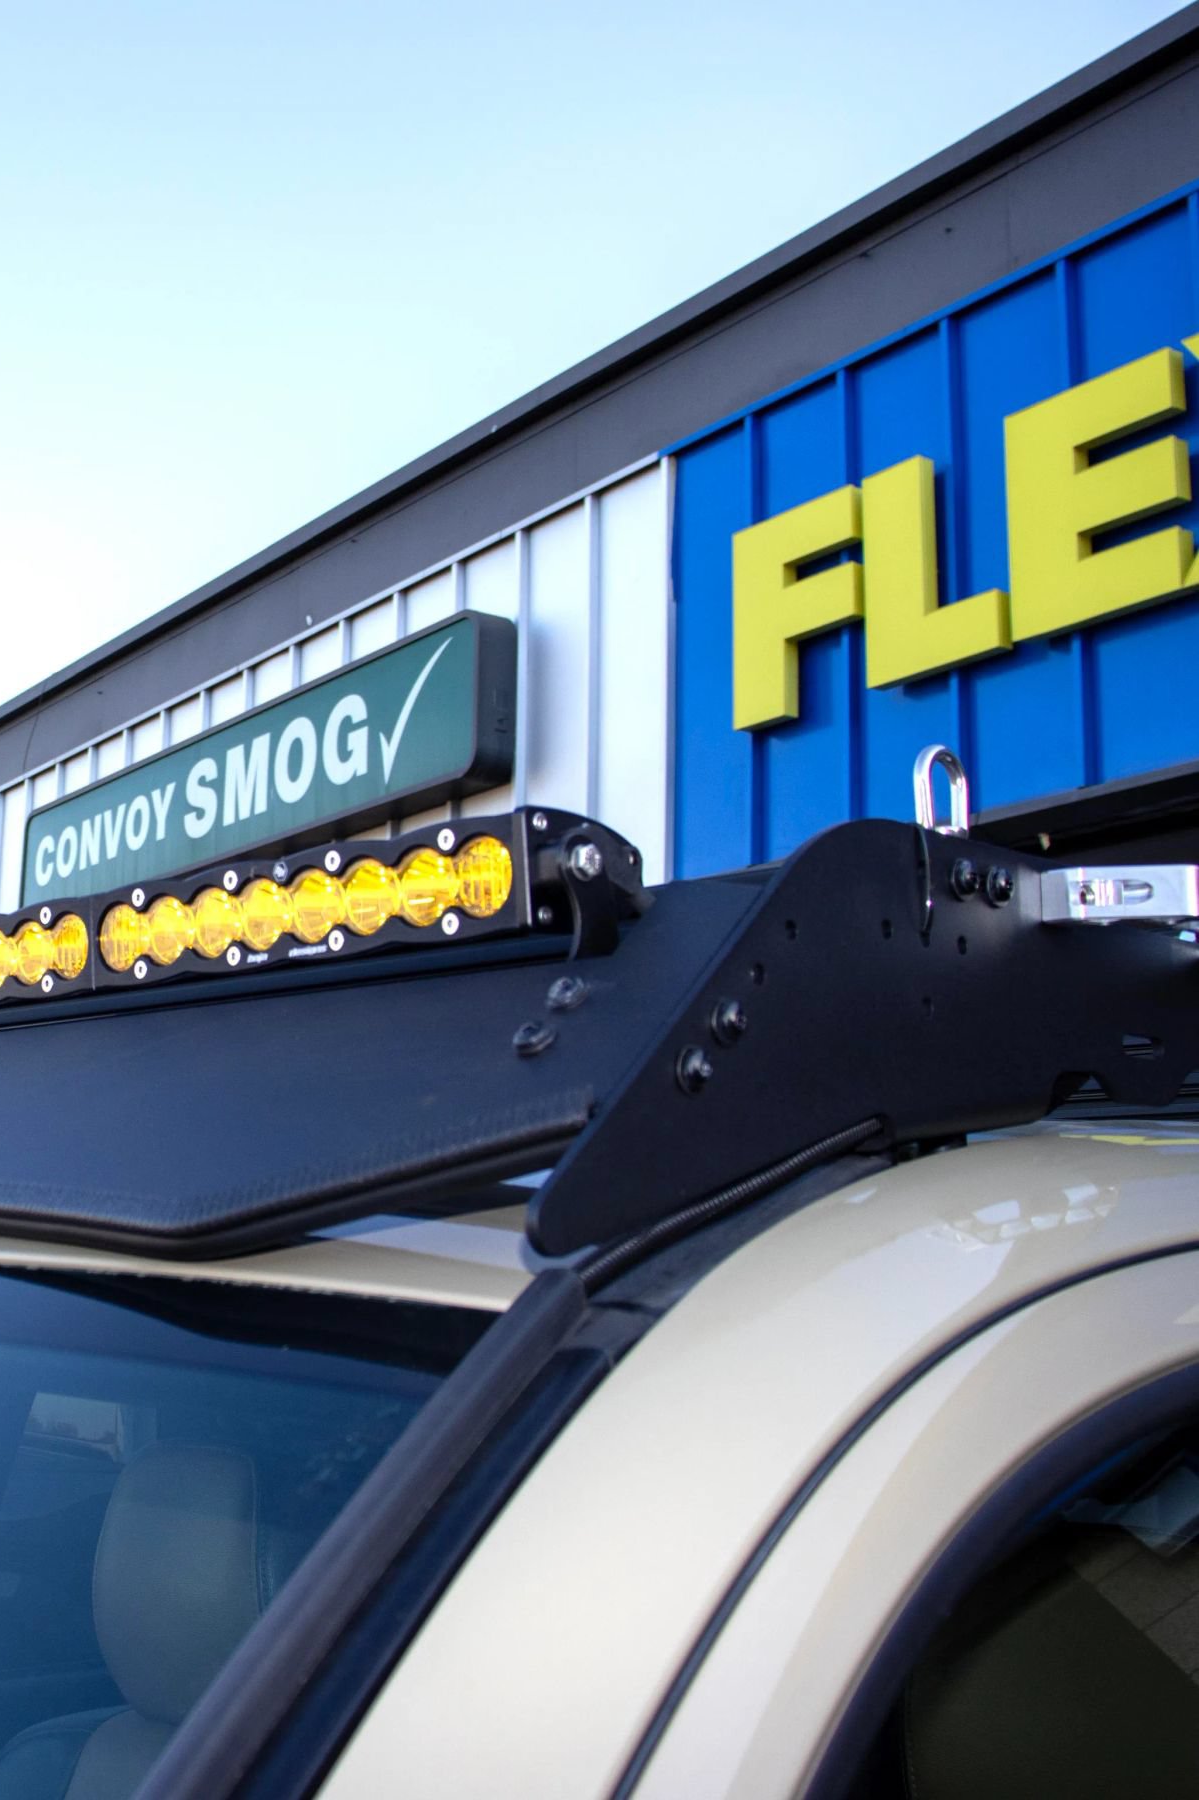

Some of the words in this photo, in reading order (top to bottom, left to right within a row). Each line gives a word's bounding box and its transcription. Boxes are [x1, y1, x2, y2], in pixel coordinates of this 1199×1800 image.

[732, 331, 1199, 731] FLE
[34, 782, 177, 887] CONVOY
[183, 693, 370, 840] SMOG
